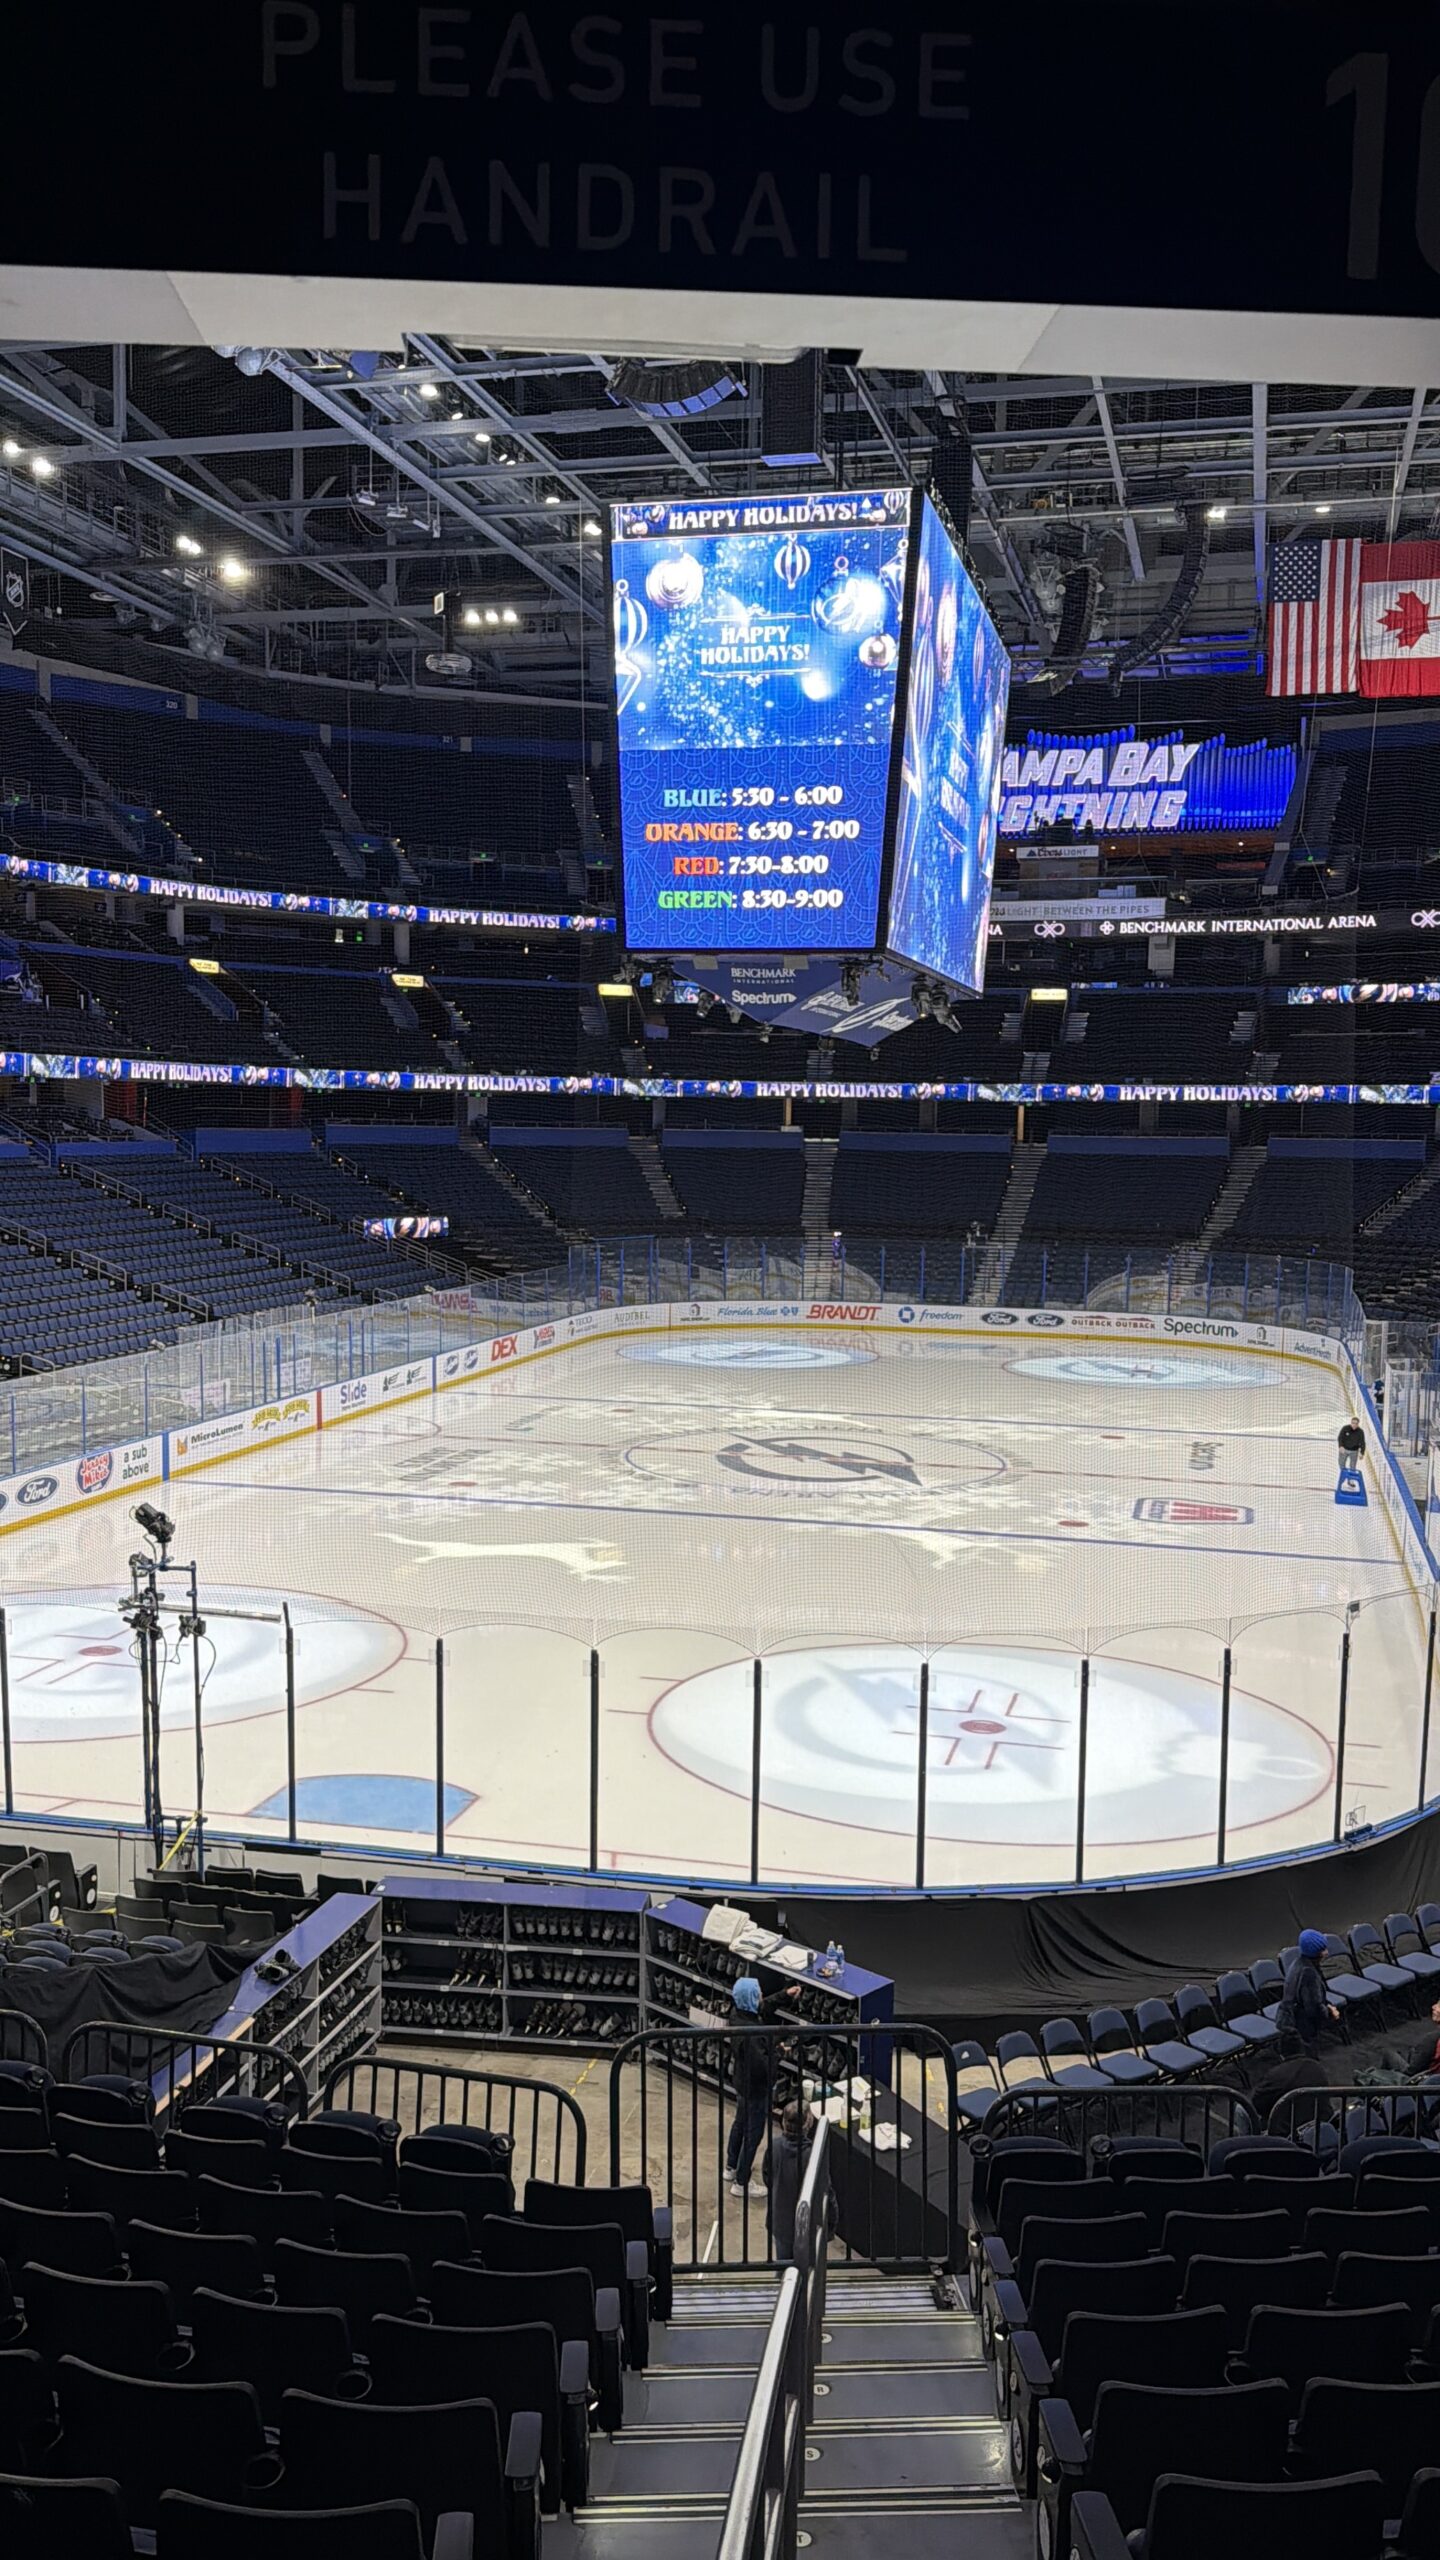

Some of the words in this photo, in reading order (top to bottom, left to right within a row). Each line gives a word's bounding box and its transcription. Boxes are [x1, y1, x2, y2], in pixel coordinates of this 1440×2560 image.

[262, 1, 704, 107] PLEASE
[761, 23, 973, 120] USE
[323, 151, 907, 262] HANDRAIL
[669, 507, 740, 530] HAPPY
[744, 502, 858, 526] HOLIDAYS!
[721, 625, 790, 645] HAPPY
[700, 643, 810, 664] HOLIDAYS!
[1002, 747, 1104, 787] AMPA
[1108, 742, 1200, 786] BAY
[663, 788, 727, 807] BLUE:
[731, 787, 775, 807] 5:30
[794, 786, 843, 805] 6:00
[1000, 790, 1188, 832] GHTNING
[645, 822, 743, 841] ORANGE:
[748, 821, 793, 840] 6:30
[812, 820, 860, 839] 7:00
[673, 856, 724, 875] RED:
[728, 855, 829, 874] 7:30-8:00
[150, 880, 195, 900] HAPPY
[197, 885, 272, 907] HOLIDAYS!
[658, 890, 737, 909] GREEN:
[742, 889, 844, 908] 8:30-9:00
[429, 909, 479, 926] HAPPY
[482, 912, 560, 929] HOLIDAYS!
[1044, 906, 1092, 915] BETWEEN
[1096, 905, 1116, 914] THE
[1120, 905, 1149, 914] PIPES
[1119, 920, 1206, 934] BENCHMARK
[1211, 917, 1323, 932] INTERNATIONAL
[1327, 915, 1377, 929] ARENA
[731, 967, 796, 978] BENCHMARK
[732, 989, 791, 1005] Spectrum
[131, 1062, 167, 1080] HAPPY
[169, 1063, 232, 1082] HOLIDAYS!
[414, 1074, 464, 1090] HAPPY
[468, 1075, 551, 1092] HOLIDAYS!
[757, 1082, 811, 1097] HAPPY
[815, 1083, 902, 1098] HOLIDAYS!
[1120, 1087, 1180, 1101] HAPPY
[1183, 1086, 1277, 1101] HOLIDAYS!
[718, 1306, 753, 1316] Florida
[756, 1306, 778, 1316] Blue
[806, 1305, 882, 1321] BRANDT
[919, 1309, 962, 1322] freedom
[987, 1311, 1012, 1325] Ford
[1033, 1314, 1058, 1327] Ford
[1071, 1319, 1113, 1328] OUTBACK
[1115, 1321, 1156, 1329] OUTBACK
[1164, 1317, 1235, 1338] Spectrum
[491, 1335, 518, 1361] DEX
[340, 1381, 367, 1405] Slide
[191, 1422, 244, 1444] MicroLumen
[123, 1452, 130, 1462] a
[132, 1445, 147, 1460] sub
[81, 1453, 109, 1475] Jersey
[122, 1462, 150, 1479] above
[23, 1480, 52, 1503] Ford
[806, 2450, 814, 2458] S
